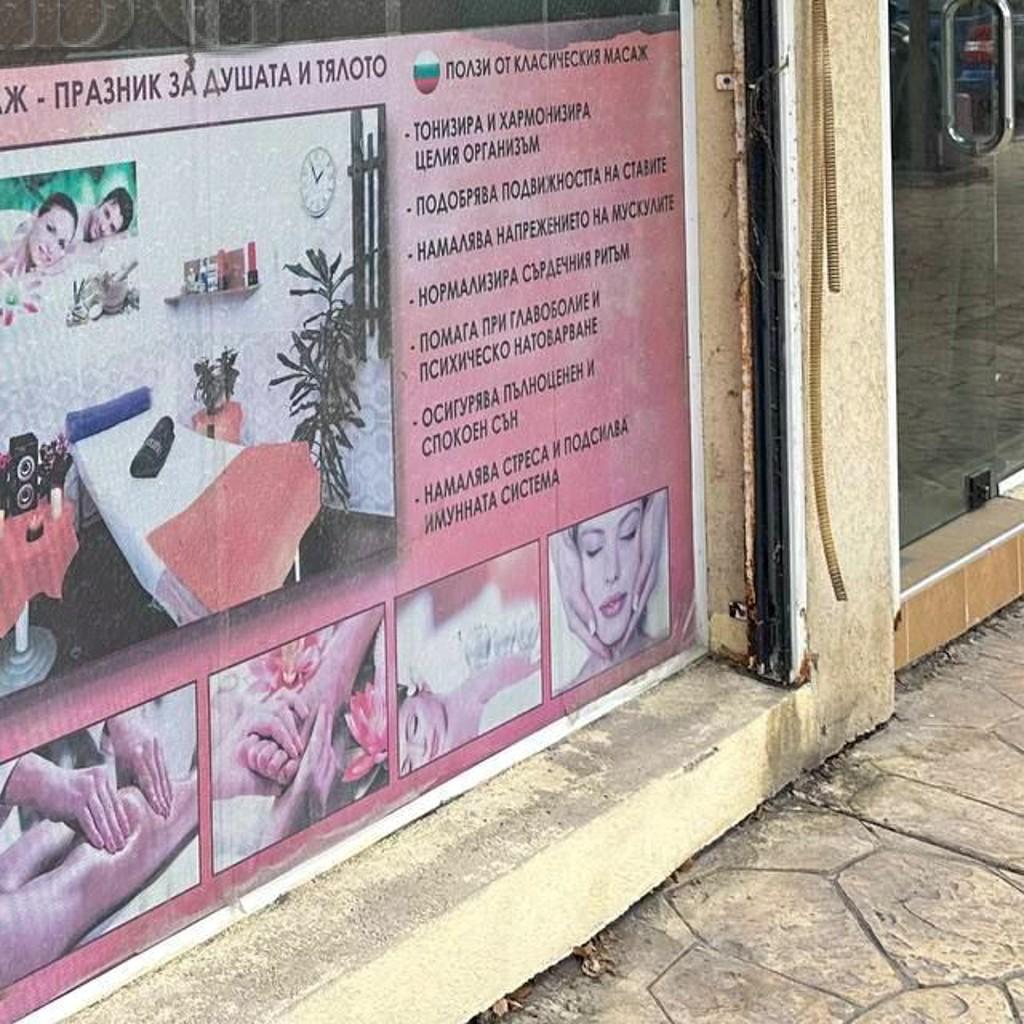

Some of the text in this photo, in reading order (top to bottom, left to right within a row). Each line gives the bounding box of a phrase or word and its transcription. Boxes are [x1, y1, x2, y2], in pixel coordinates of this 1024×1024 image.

[55, 75, 162, 109] ПРАЗНИК
[169, 71, 198, 98] ЗА
[203, 63, 292, 97] ДУШАТА
[299, 61, 310, 85] И
[317, 55, 387, 84] ТЯЛОТО
[446, 45, 648, 80] ПОЛЗИ ОТ КЛАСИЧЕСКИЯ МАСАЖ
[414, 102, 591, 141] ТОНИЗИРА И ХАРМОНИЗИРА
[416, 136, 540, 170] ЦЕЛИЯ ОРГАНИЗЪМ
[416, 157, 666, 216] ПОДОБРЯВА ПОДВИЖНОСТТА НА СТАВИТЕ
[418, 194, 675, 262] НАМАЛЯВА НАПРЕЖЕНИЕТО НА МУСКУЛИТЕ
[419, 243, 630, 306] НОРМАЛИЗИРА СЪРДЕЧНИЯ РИТЪМ
[420, 290, 599, 353] ПОМАГА ПРИ ГЛАВОБОЛИЕ И
[420, 317, 598, 382] ПСИХИЧЕСКО НАТОВАРВАНЕ
[423, 359, 595, 426] ОСИГУРЯВА ПЪЛНОЦЕНЕН И
[422, 410, 518, 456] СПОКОЕН СЪН
[425, 418, 628, 504] НАМАЛЯВА СТРЕСА И ПОДСИЛВА
[425, 469, 560, 534] ИМУННАТА СИСТЕМА
